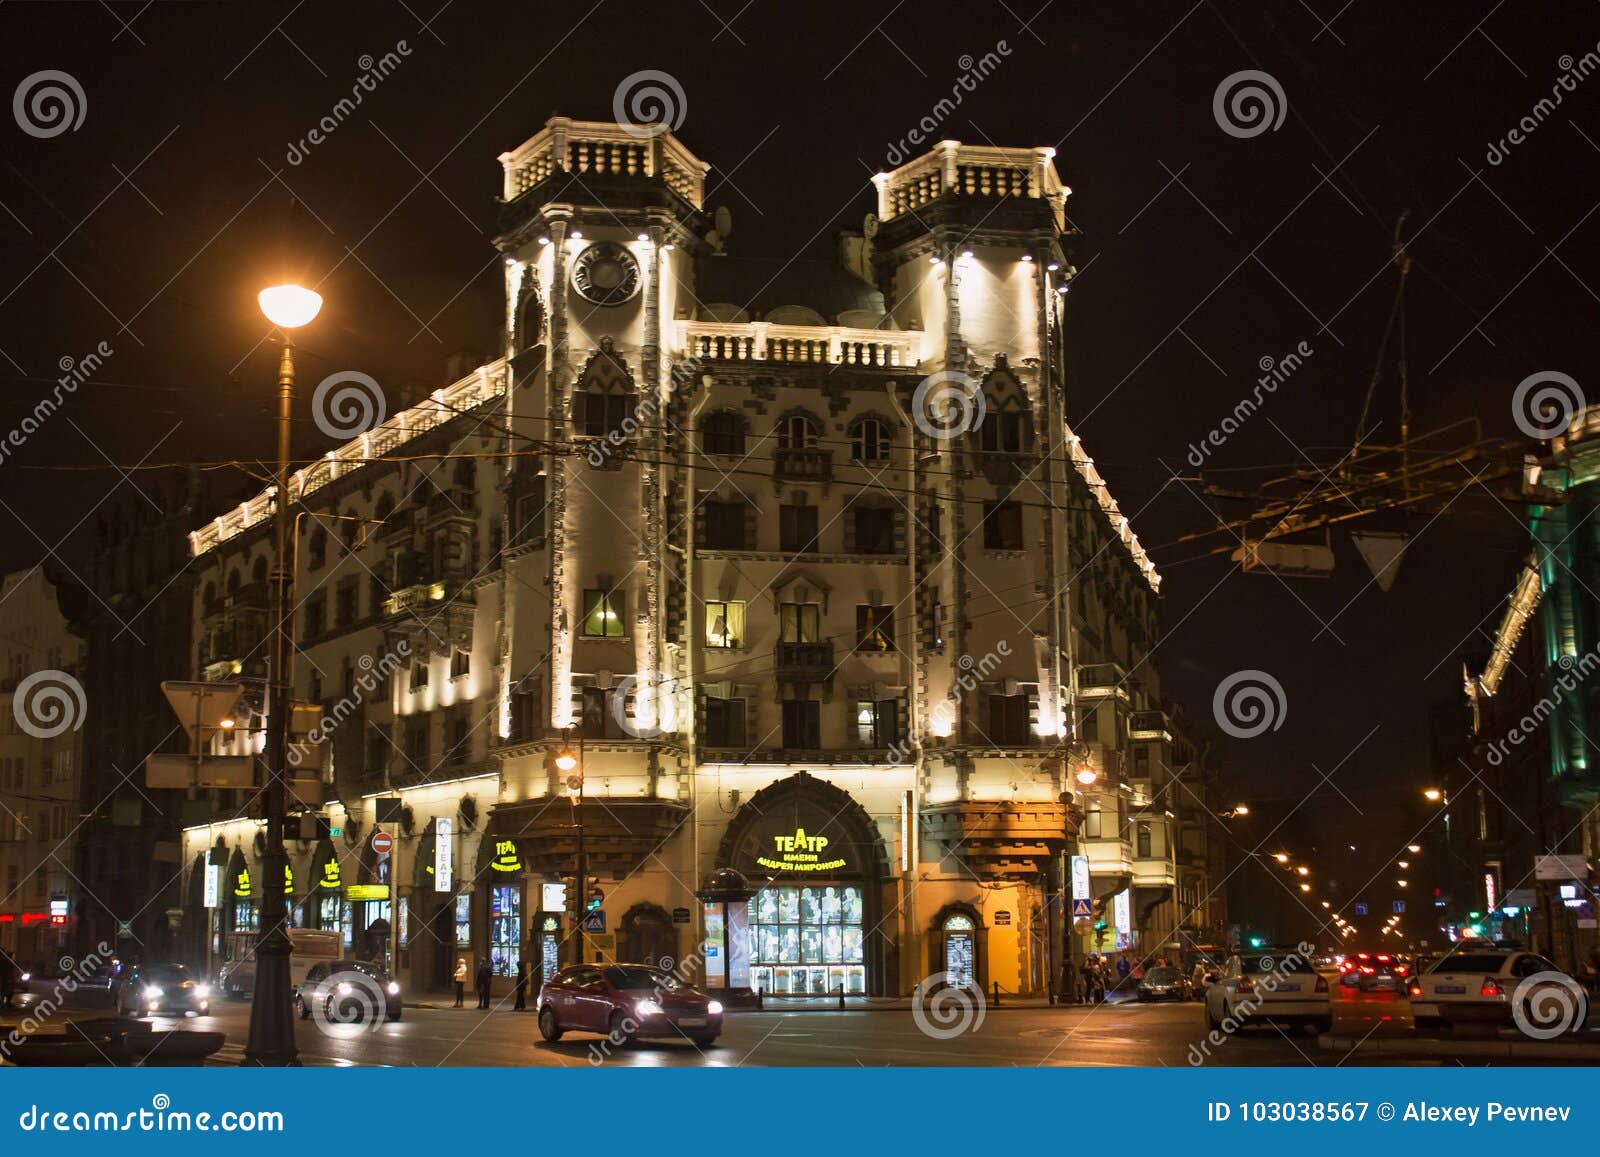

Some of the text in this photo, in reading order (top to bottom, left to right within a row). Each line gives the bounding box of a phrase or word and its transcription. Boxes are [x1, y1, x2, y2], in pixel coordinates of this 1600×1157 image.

[774, 828, 828, 852] ТЕАТР
[440, 844, 448, 889] ТЕАТР
[756, 857, 846, 871] АНДРЕЯ МИРОНОВА
[783, 854, 818, 862] ИМЕНИ
